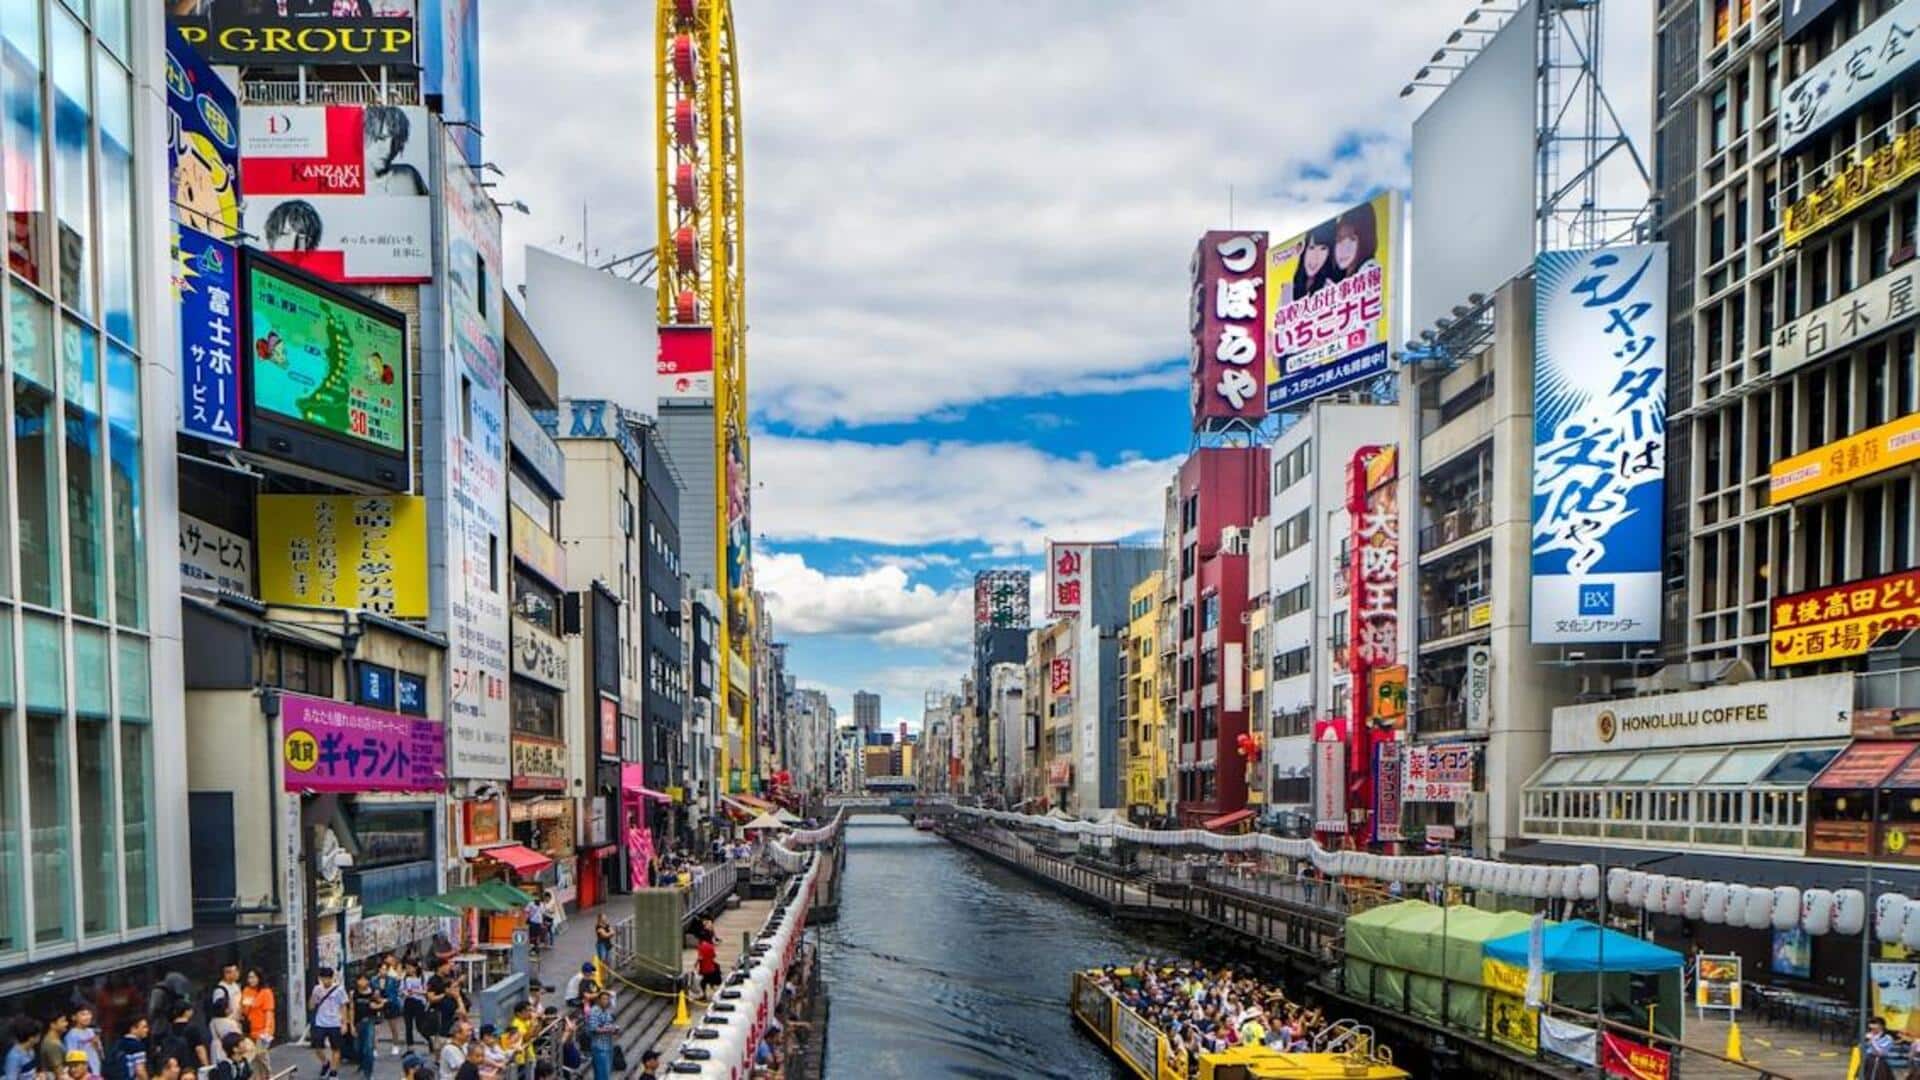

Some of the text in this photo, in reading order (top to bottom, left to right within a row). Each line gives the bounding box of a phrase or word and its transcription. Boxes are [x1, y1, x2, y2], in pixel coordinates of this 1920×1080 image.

[219, 27, 412, 51] GROUP
[1846, 23, 1920, 93] 完全
[1216, 233, 1263, 410] つぼらや
[1275, 297, 1381, 353] いちごナビ
[1775, 276, 1915, 358] 4F 白木屋
[190, 344, 207, 423] サービス
[207, 285, 234, 436] 富士ホーム
[1572, 251, 1665, 478] シャッターは
[1358, 507, 1398, 667] 大阪王将
[1583, 590, 1610, 607] BX
[1621, 704, 1768, 731] HONOLULU COFFEE
[319, 732, 410, 779] ギャラント
